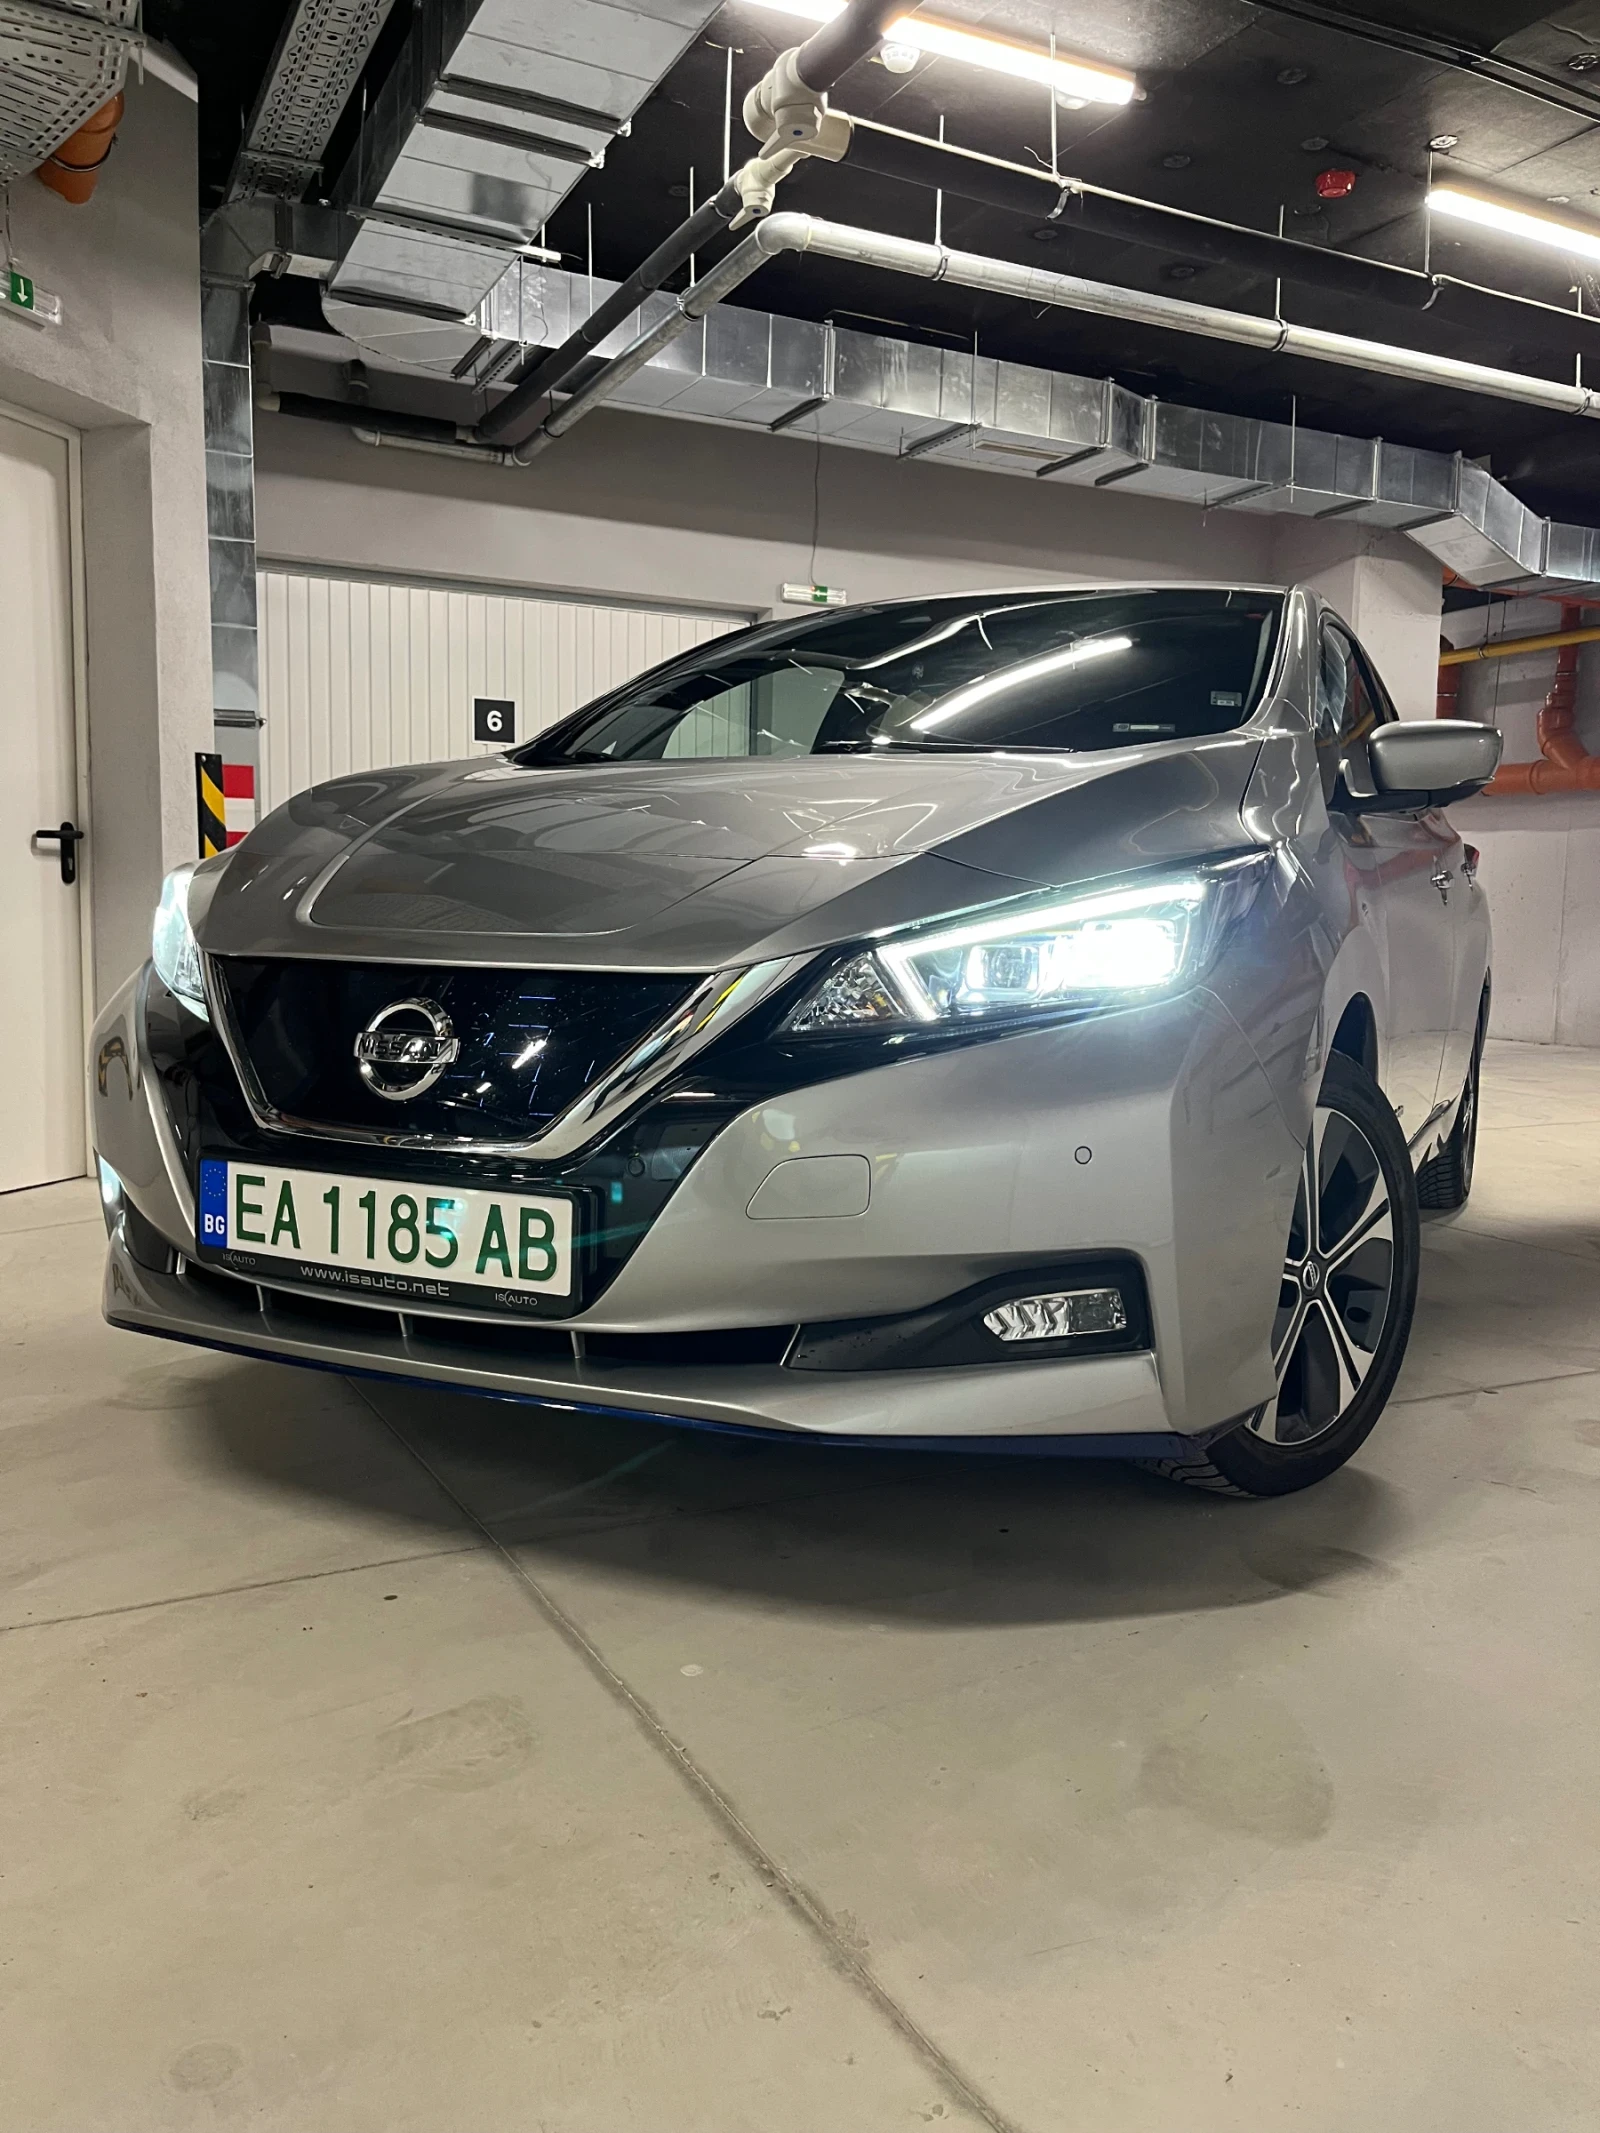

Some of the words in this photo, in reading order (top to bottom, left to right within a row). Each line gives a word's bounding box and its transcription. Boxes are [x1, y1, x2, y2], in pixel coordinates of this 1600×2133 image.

[486, 710, 503, 732] 6
[204, 1213, 225, 1235] BG
[236, 1173, 301, 1249] EA
[323, 1185, 459, 1268] 1185
[475, 1204, 557, 1281] AB
[300, 1265, 450, 1297] www.isauto.net
